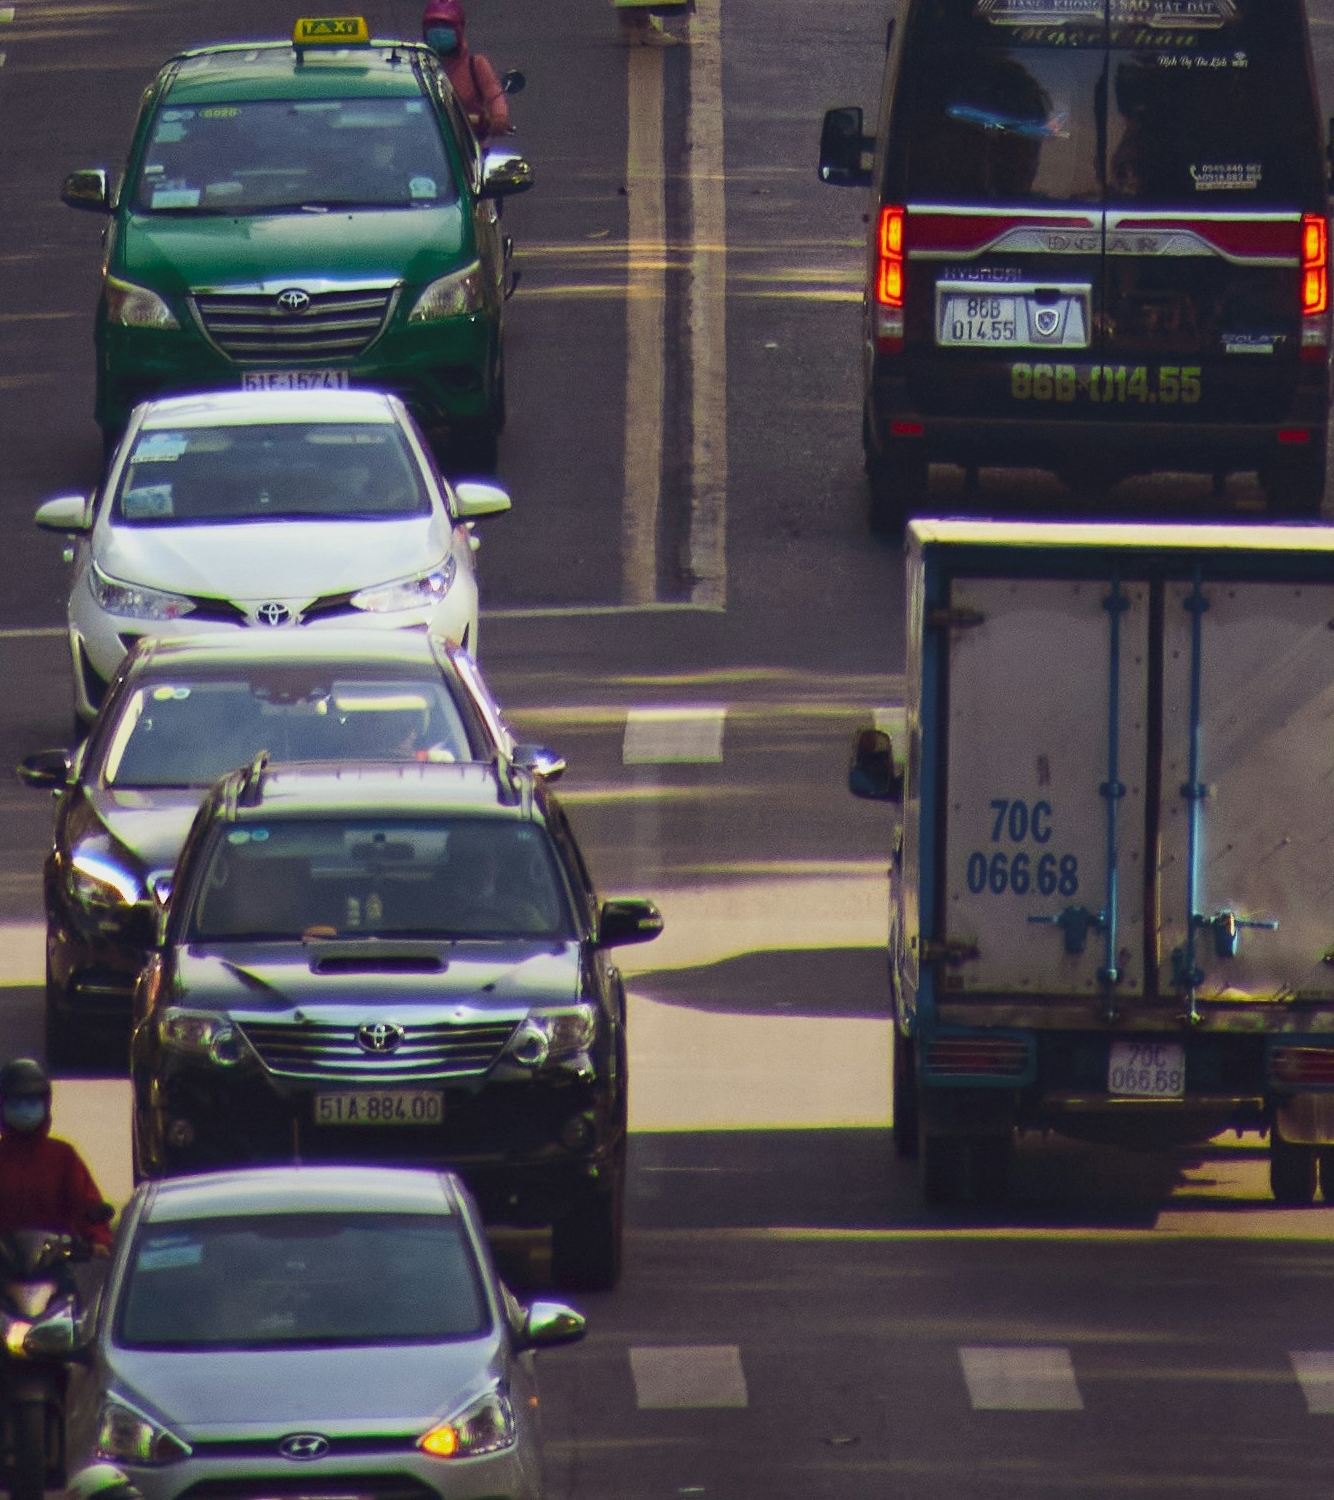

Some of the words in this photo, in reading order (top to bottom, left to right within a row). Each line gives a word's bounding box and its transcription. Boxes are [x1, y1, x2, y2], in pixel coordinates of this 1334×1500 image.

[967, 298, 1002, 319] 86B
[951, 319, 1015, 342] 014.55
[989, 799, 1053, 844] 70C
[966, 852, 1079, 896] 066.68
[316, 1093, 443, 1124] 51A-884.00
